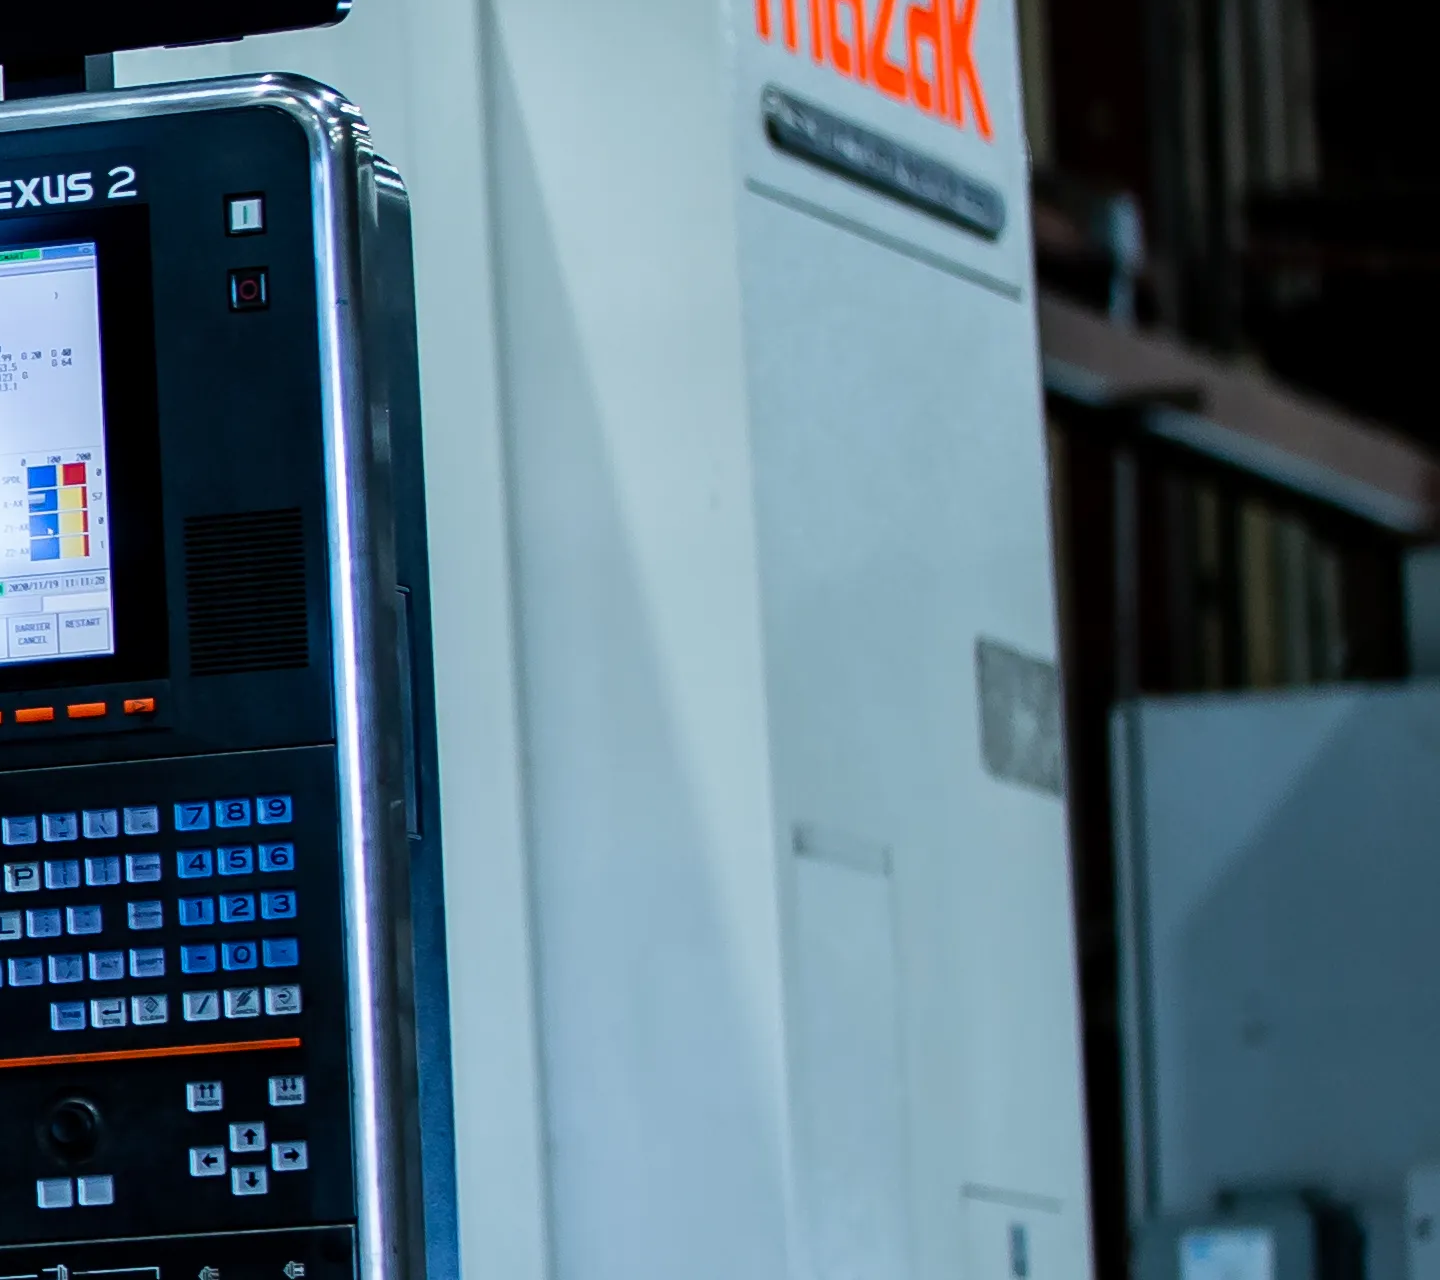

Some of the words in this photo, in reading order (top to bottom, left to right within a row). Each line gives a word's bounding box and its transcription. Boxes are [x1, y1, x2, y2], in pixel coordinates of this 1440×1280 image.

[107, 166, 137, 199] 2
[64, 616, 101, 629] RESTART
[185, 805, 204, 825] 7
[225, 801, 244, 822] 8
[267, 797, 287, 819] 9
[187, 852, 206, 872] 4
[229, 848, 247, 868] 5
[269, 845, 289, 865] 6
[13, 866, 34, 887] P
[194, 901, 204, 919] 1
[230, 897, 249, 917] 2
[271, 893, 291, 913] 3
